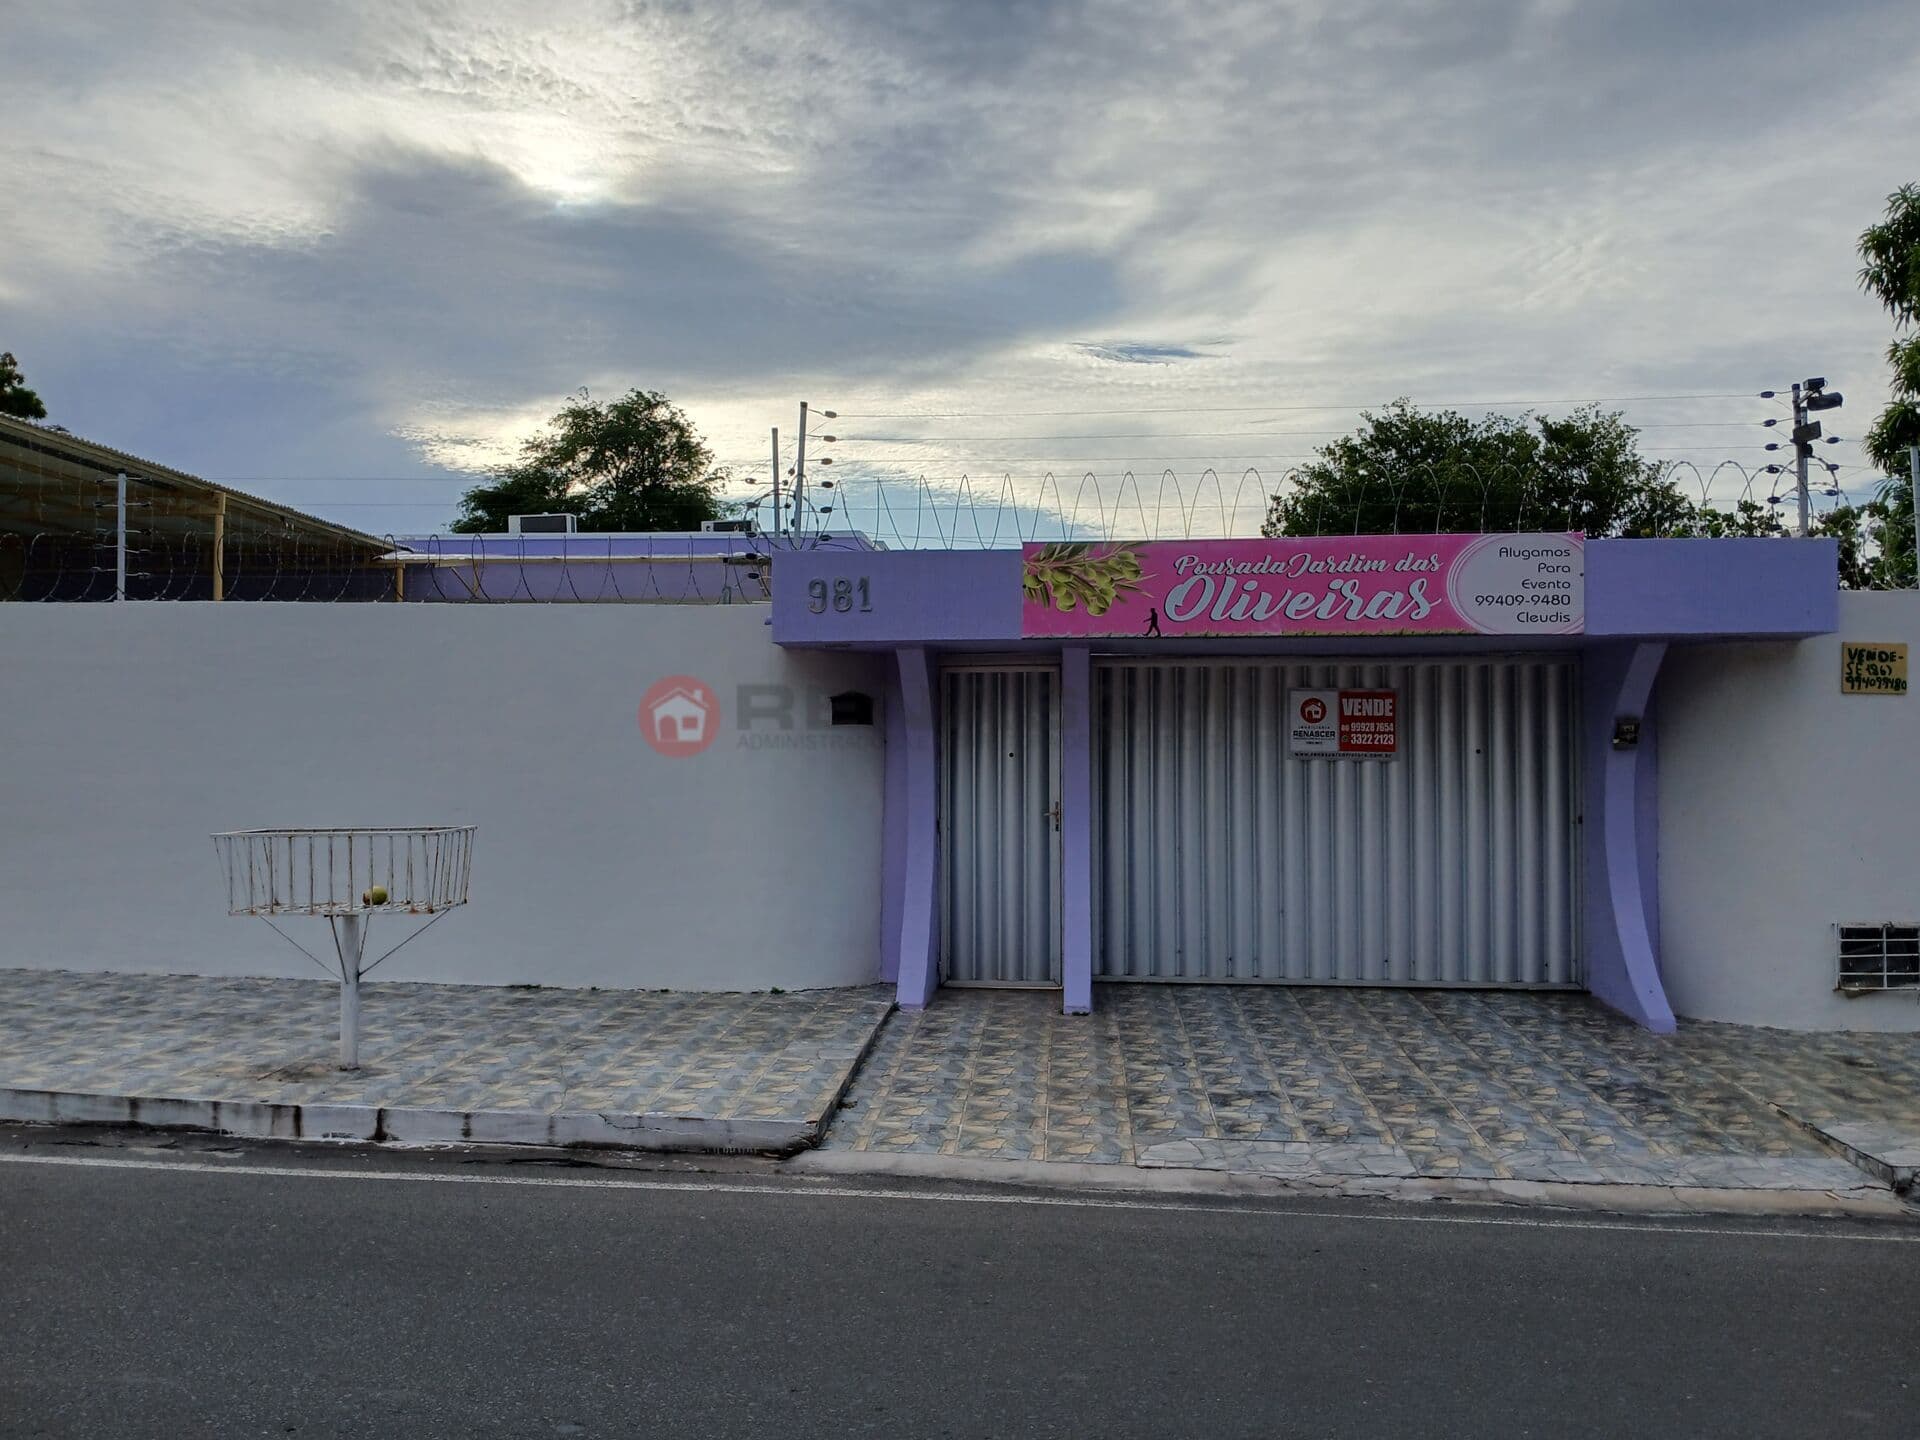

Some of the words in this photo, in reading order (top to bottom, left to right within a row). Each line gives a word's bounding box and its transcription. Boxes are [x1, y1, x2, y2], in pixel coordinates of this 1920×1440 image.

[1499, 546, 1571, 561] Alugamos
[1173, 554, 1289, 575] Pousada
[1287, 552, 1388, 579] Jardim
[1394, 552, 1445, 573] das
[1537, 563, 1571, 574] Para
[1520, 579, 1571, 590] Evento
[807, 575, 873, 615] 981
[1163, 574, 1443, 623] Oliveiras
[1474, 594, 1571, 607] 99409-9480
[1516, 611, 1571, 623] Cleudis
[1342, 698, 1393, 717] VENDE
[1292, 730, 1336, 738] RENASCER
[1350, 733, 1373, 745] 3322
[1374, 733, 1394, 745] 2123
